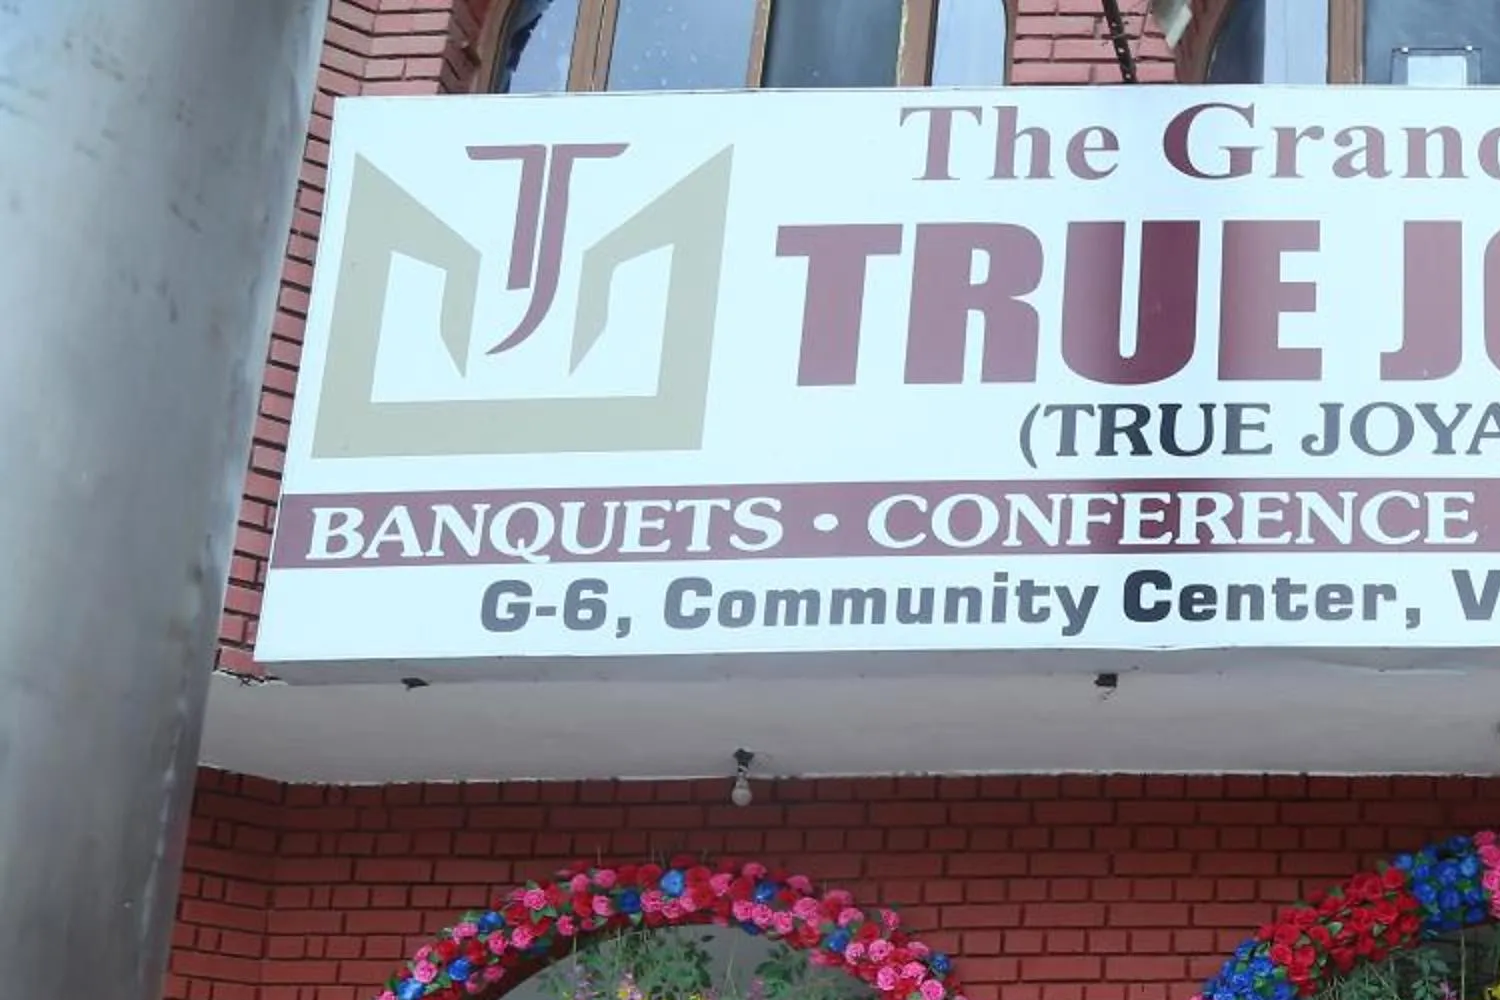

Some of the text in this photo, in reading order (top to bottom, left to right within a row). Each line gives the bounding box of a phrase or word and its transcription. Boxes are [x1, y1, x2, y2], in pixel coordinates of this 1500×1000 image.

[899, 105, 1121, 181] The
[775, 219, 1323, 387] TRUE
[1019, 402, 1273, 469] (TRUE
[305, 496, 784, 563] BANQUETS
[867, 489, 1479, 549] CONFERENCE
[479, 577, 632, 640] G-6,
[663, 571, 1101, 637] Community
[1122, 569, 1421, 629] Center,
